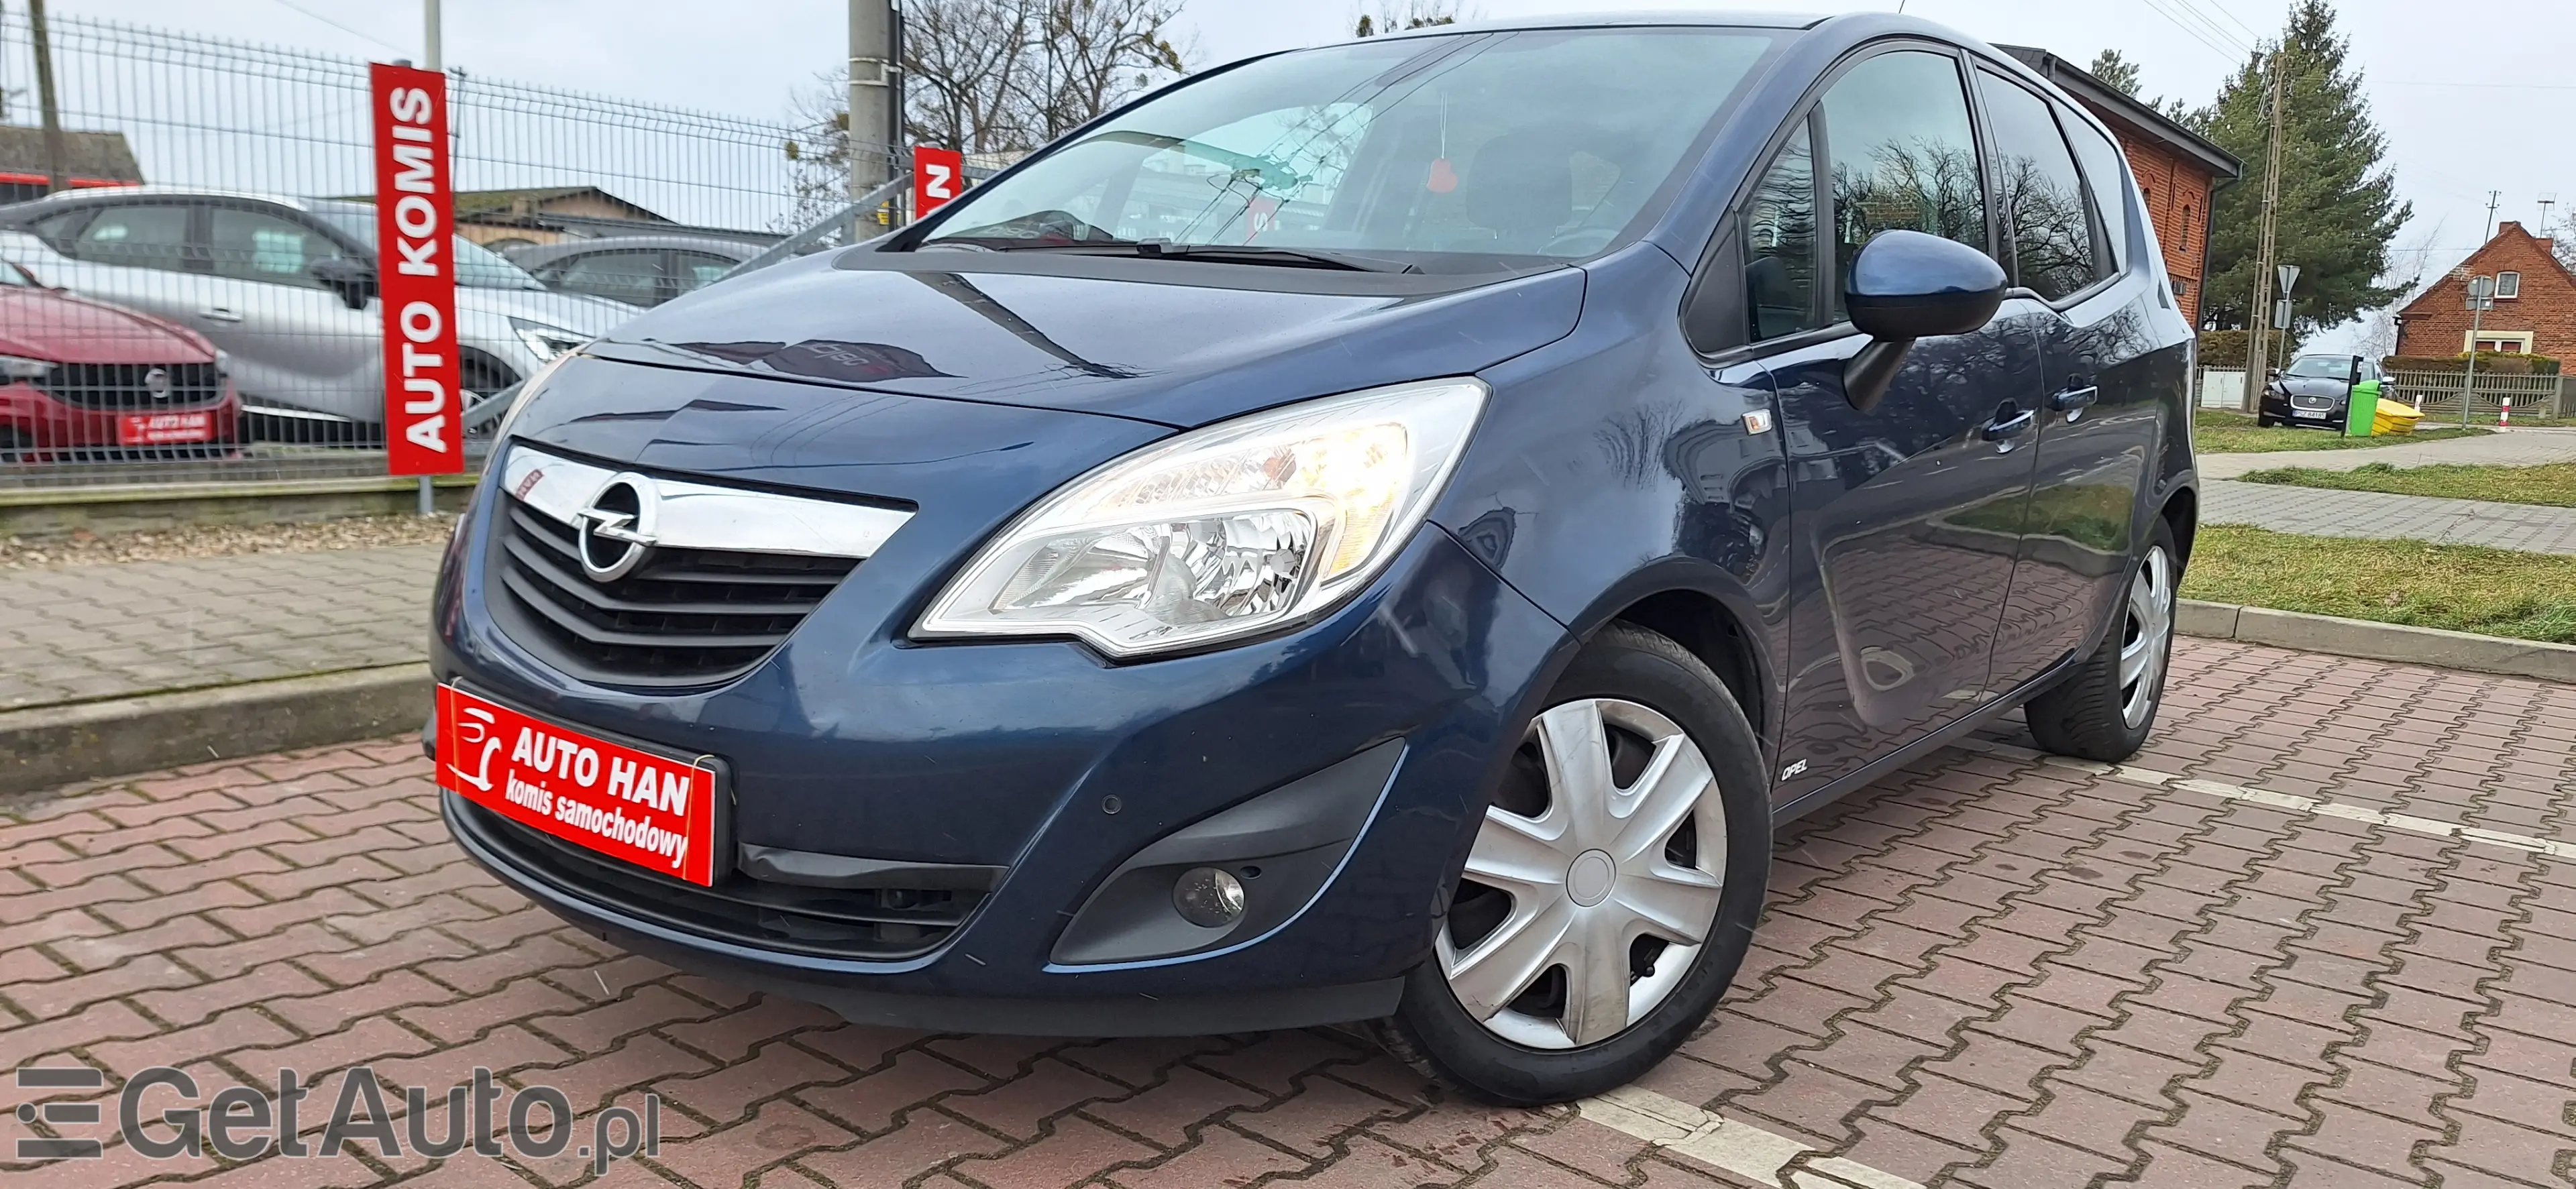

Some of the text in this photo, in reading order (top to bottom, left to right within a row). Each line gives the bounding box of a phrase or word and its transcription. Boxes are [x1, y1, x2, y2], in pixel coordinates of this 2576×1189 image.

[926, 164, 951, 213] N
[390, 87, 447, 453] AUTO KOMIS
[511, 726, 690, 816] AUTO HAN
[1781, 758, 1808, 781] OPEL
[505, 769, 688, 869] komis samochodowy
